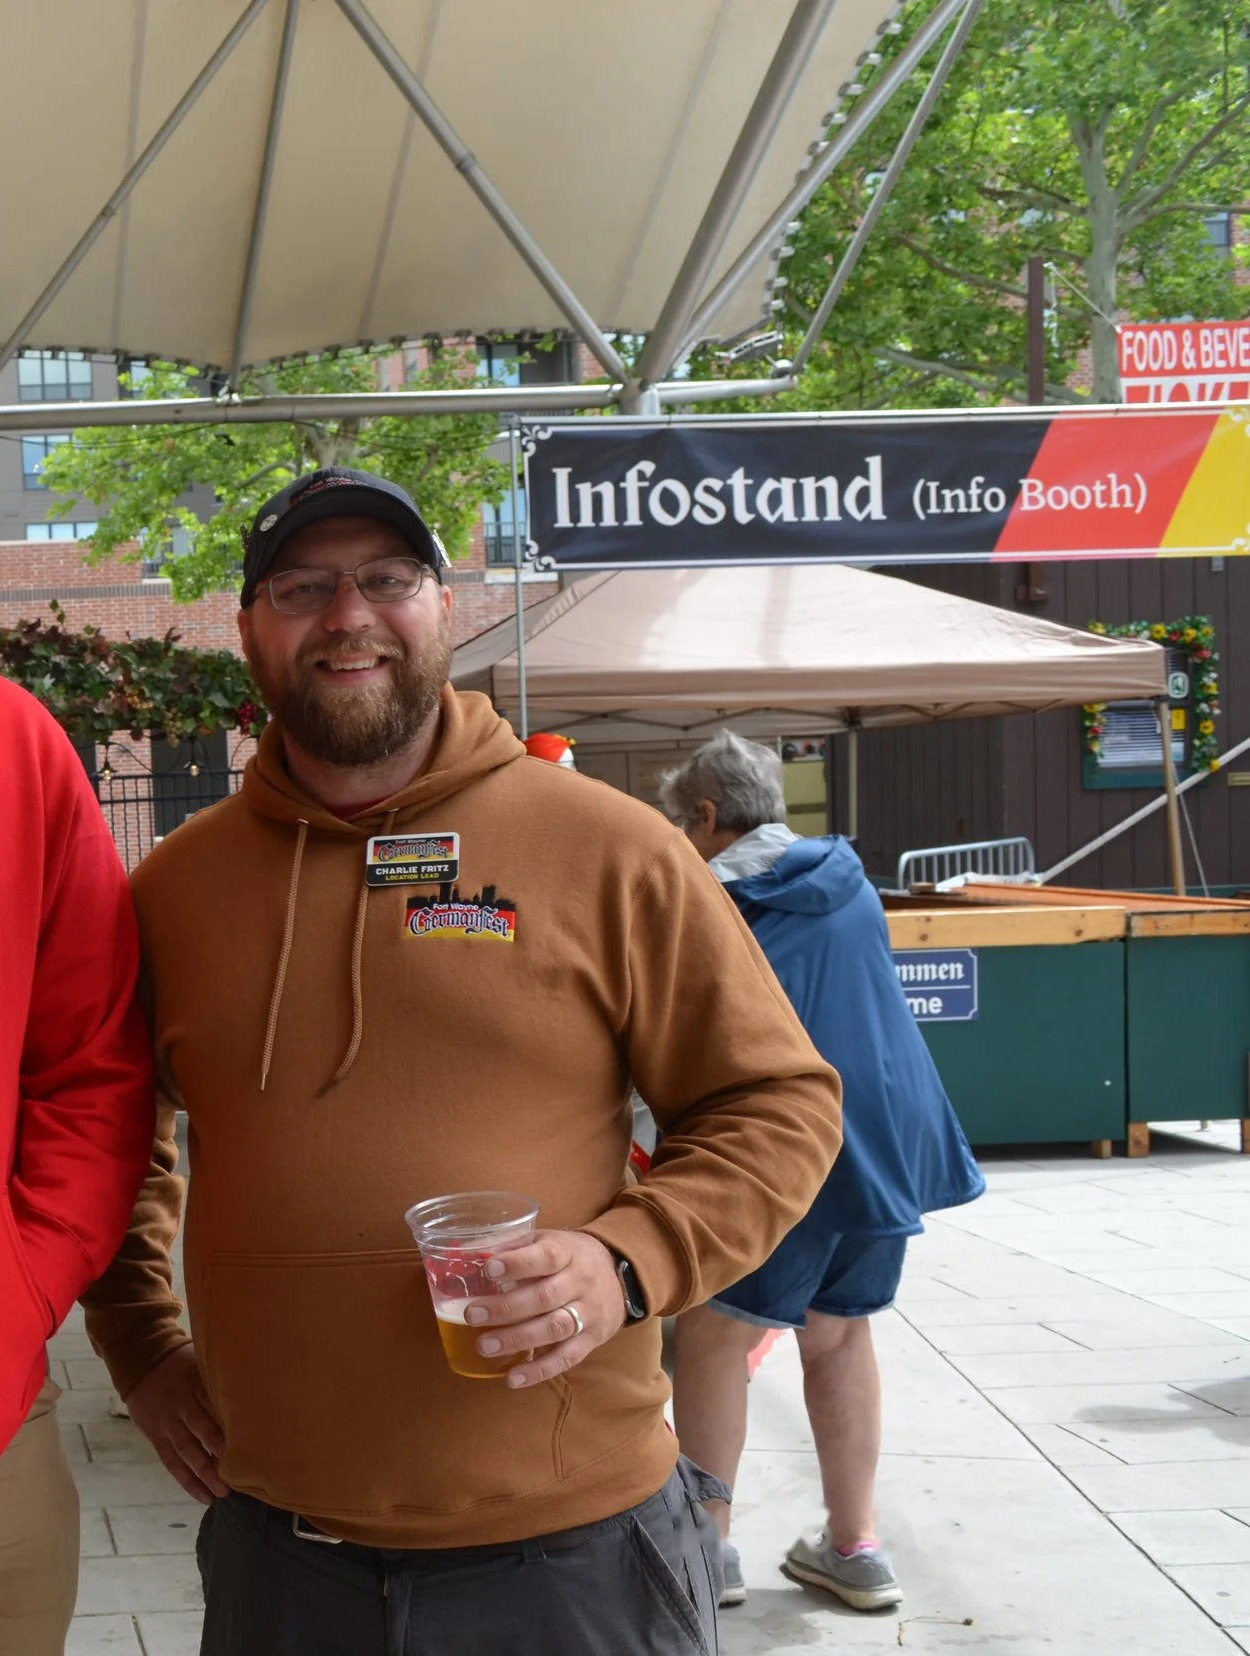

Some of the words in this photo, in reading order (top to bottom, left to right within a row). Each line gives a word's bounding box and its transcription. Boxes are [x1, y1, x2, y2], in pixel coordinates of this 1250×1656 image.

[1122, 330, 1177, 372] FOOD
[1182, 329, 1197, 370] &
[552, 455, 887, 528] Infostand
[912, 478, 1006, 521] (Info
[1020, 472, 1148, 515] Booth)
[375, 866, 418, 876] CHARLIE
[421, 864, 449, 873] FRITZ
[385, 873, 419, 881] LOCATION
[450, 903, 479, 911] Wayne
